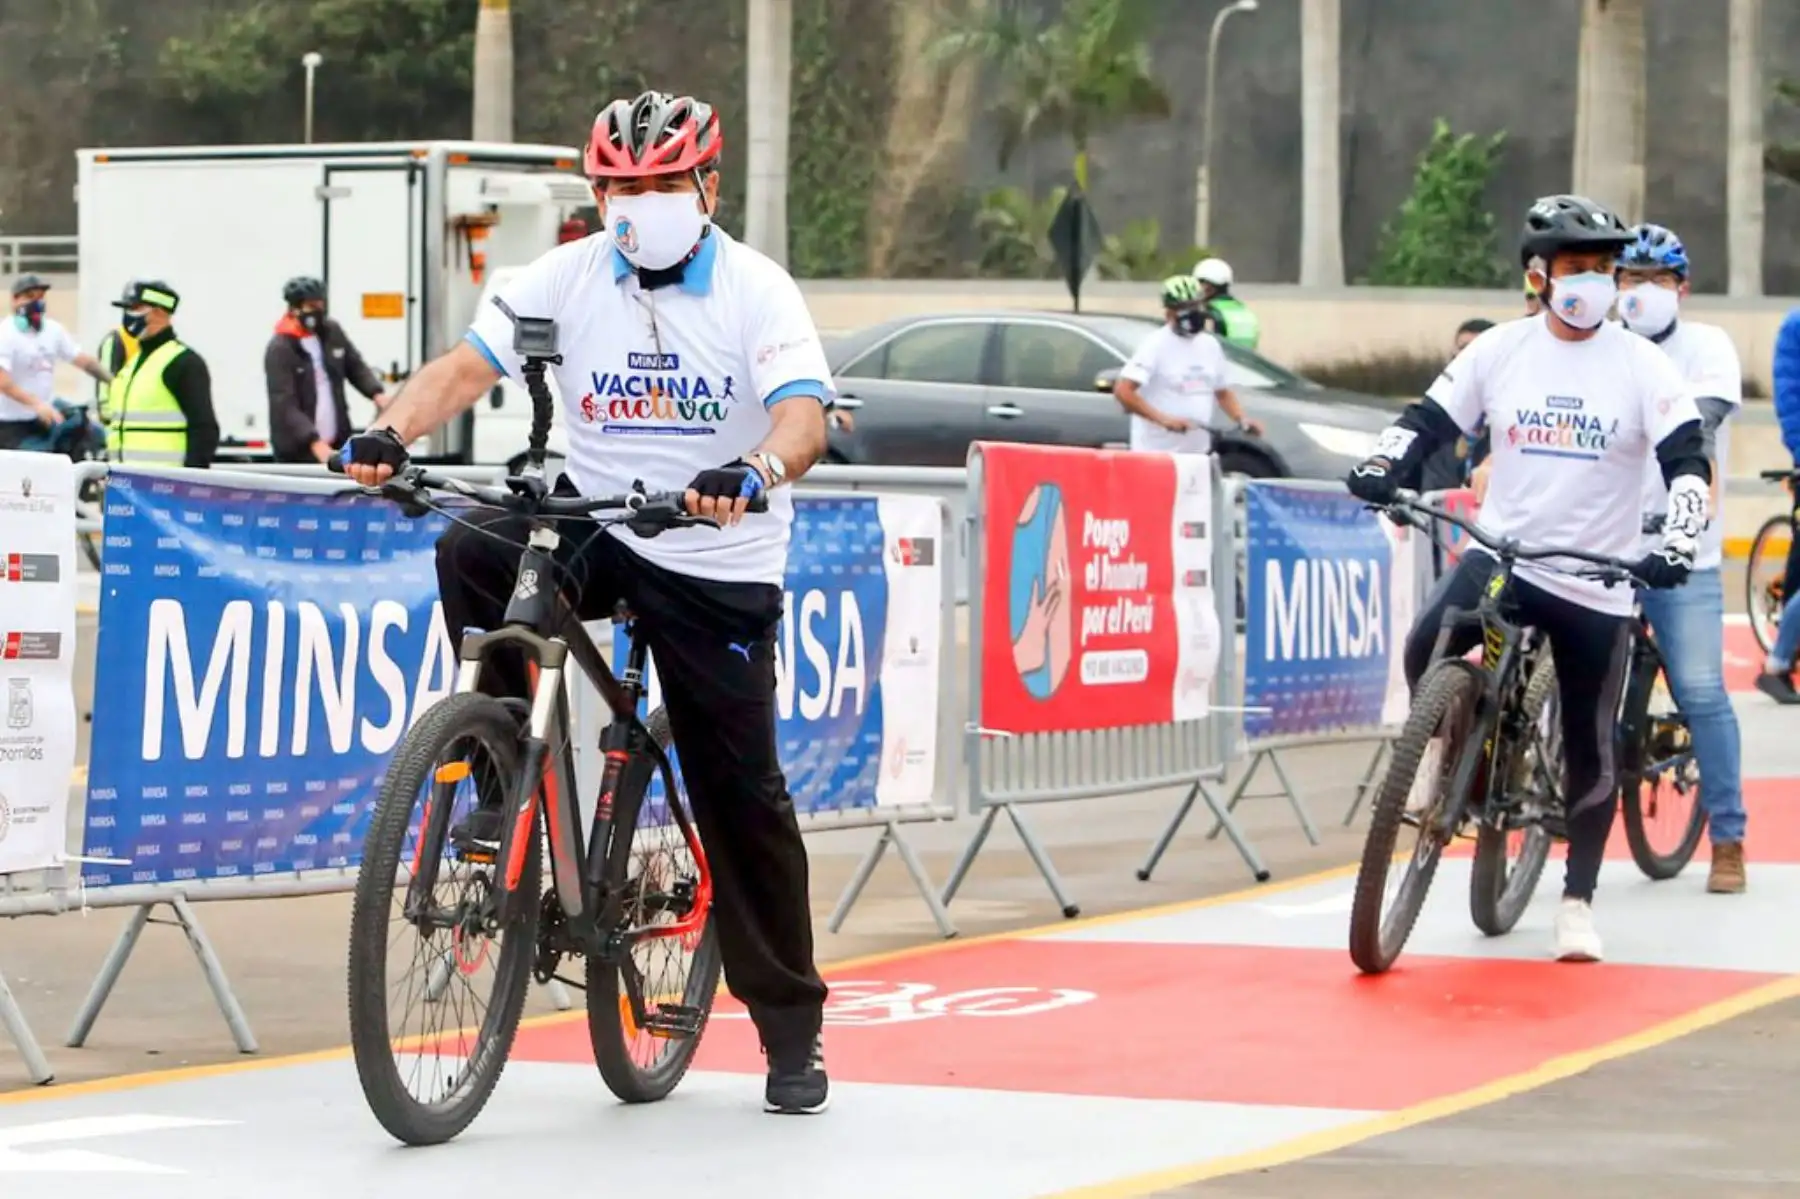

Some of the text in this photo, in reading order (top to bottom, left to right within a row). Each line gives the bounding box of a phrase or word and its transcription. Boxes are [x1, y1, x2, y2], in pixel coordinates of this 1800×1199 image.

[591, 371, 712, 400] VACUNA
[609, 385, 728, 422] activa
[1516, 409, 1602, 431] VACUNA
[1527, 420, 1608, 449] activa
[1082, 510, 1129, 558] Pongo
[1085, 553, 1099, 591] el
[1081, 592, 1153, 647] por el Perú
[1265, 558, 1384, 662] MINSA
[774, 588, 866, 721] NSA
[141, 598, 457, 760] MINSA
